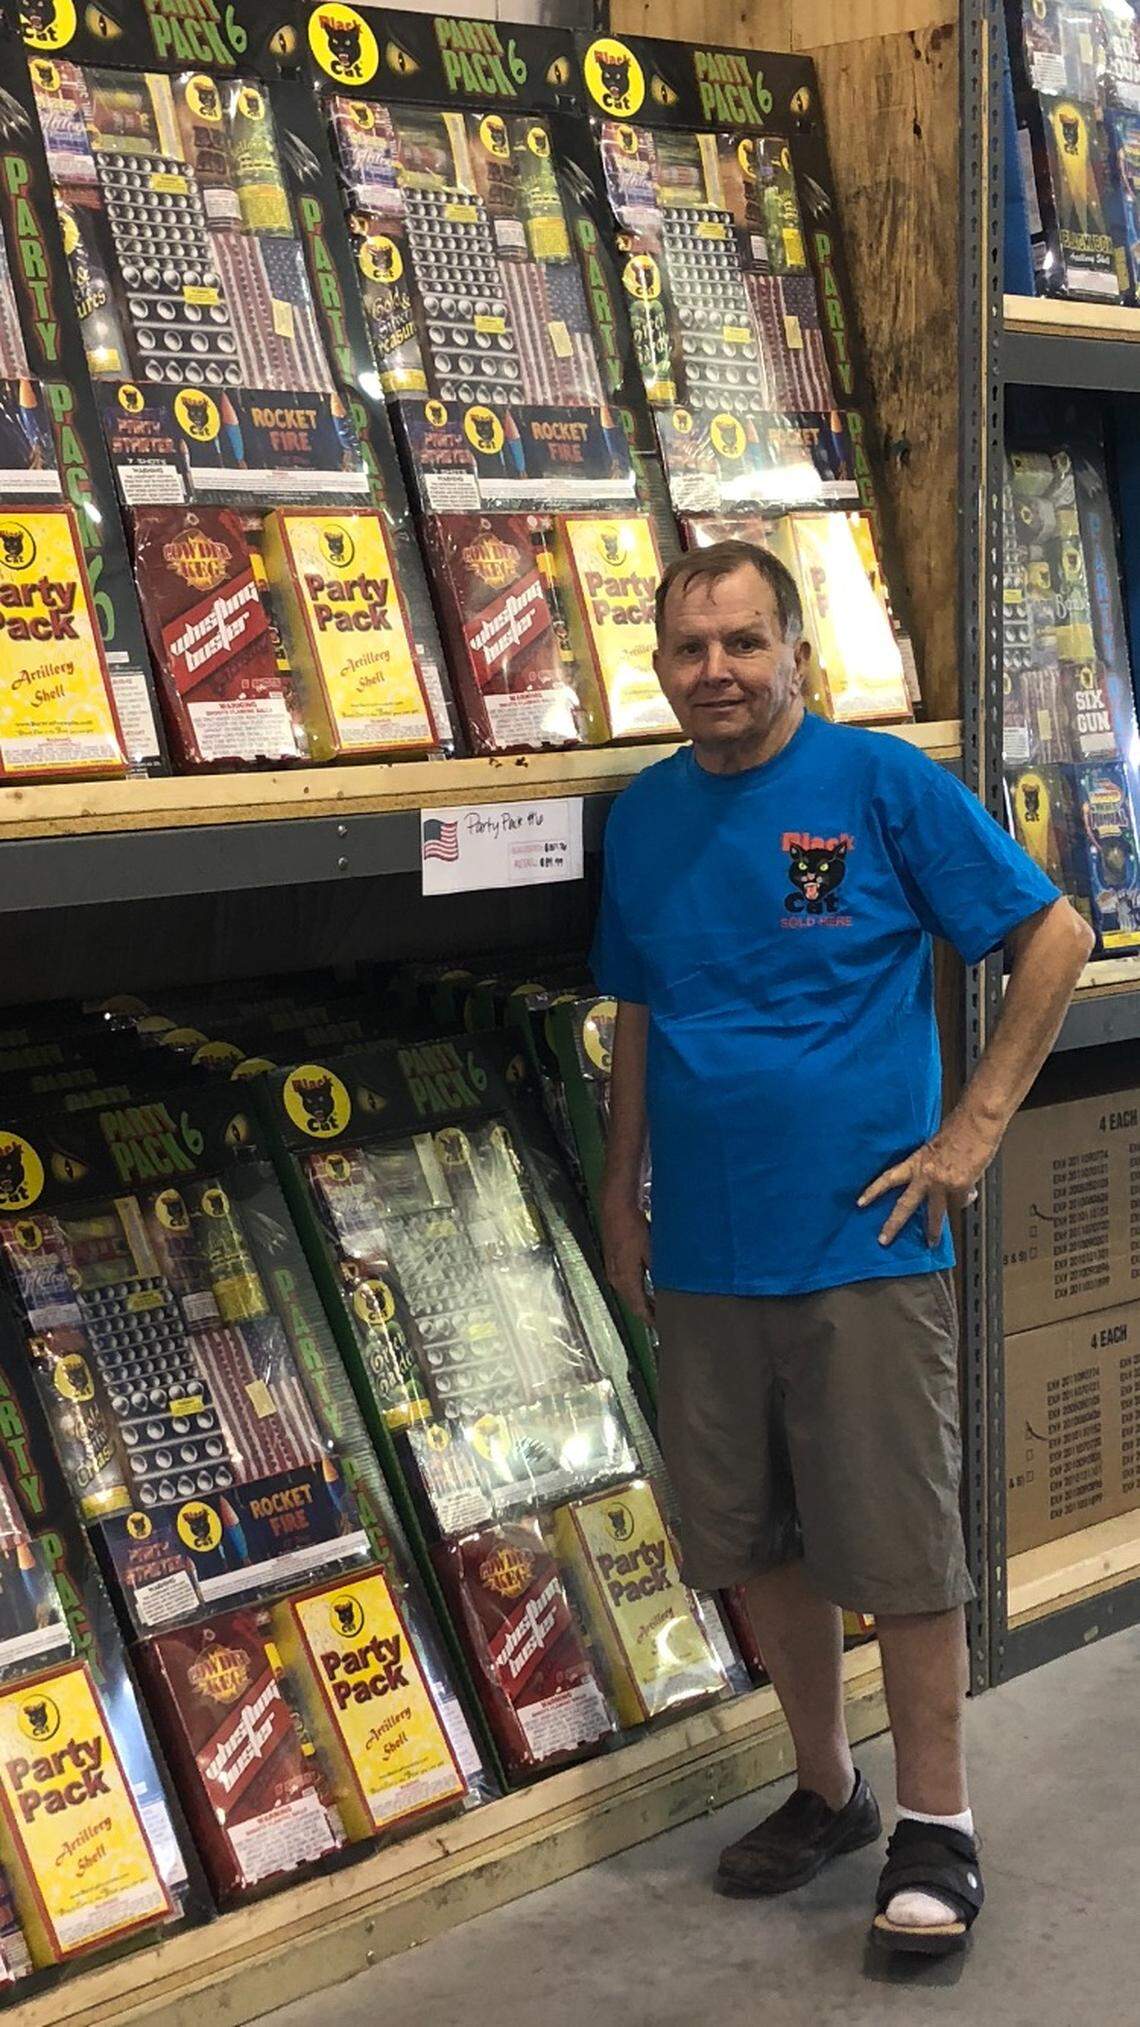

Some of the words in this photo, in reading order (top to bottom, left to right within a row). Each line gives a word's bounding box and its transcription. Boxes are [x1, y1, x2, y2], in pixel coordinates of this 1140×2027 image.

[150, 13, 237, 65] PACK
[226, 4, 247, 53] 6
[434, 17, 504, 57] PARTY
[331, 59, 364, 79] Cat
[442, 49, 518, 97] PACK
[507, 38, 527, 85] 6
[694, 50, 754, 86] PARTY
[602, 93, 632, 110] Cat
[701, 81, 764, 125] PACK
[756, 70, 773, 114] 6
[4, 156, 58, 361] PARTY
[301, 197, 355, 387] PARTY
[577, 217, 623, 392] PARTY
[815, 233, 852, 395] PARTY
[250, 407, 317, 430] ROCKET
[530, 420, 589, 443] ROCKET
[269, 431, 312, 452] FIRE
[548, 442, 583, 463] FIRE
[0, 576, 78, 615] arty
[303, 572, 389, 608] Party
[584, 571, 657, 606] Party
[0, 608, 81, 642] ack
[313, 602, 393, 633] Pack
[11, 659, 76, 691] Artillery
[340, 649, 392, 678] Artillery
[30, 683, 66, 708] Shell
[355, 673, 387, 694] Shell
[1075, 689, 1105, 712] SIX
[1076, 710, 1112, 733] GUN
[464, 811, 501, 840] Party
[780, 917, 816, 929] SOLD
[818, 915, 854, 928] HERE
[292, 1073, 334, 1093] Black
[408, 1071, 482, 1116] PACK
[467, 1050, 487, 1092] 6
[306, 1116, 339, 1133] Cat
[1099, 1115, 1107, 1133] 4
[1109, 1108, 1139, 1131] EACH
[111, 1132, 197, 1183] PACK
[181, 1110, 205, 1156] 6
[1091, 1333, 1099, 1350] 4
[1100, 1324, 1128, 1348] EACH
[0, 1371, 43, 1513] RTY
[249, 1483, 313, 1520] ROCKET
[268, 1512, 309, 1536] FIRE
[597, 1538, 666, 1581] Party
[606, 1565, 672, 1608] Pack
[320, 1634, 401, 1681] Party
[332, 1664, 410, 1711] Pack
[365, 1705, 413, 1751] Artillery
[5, 1735, 102, 1792] Party
[382, 1733, 409, 1762] Shell
[18, 1768, 111, 1824] Pack
[55, 1815, 114, 1868] Artillery
[75, 1843, 108, 1879] Shell
